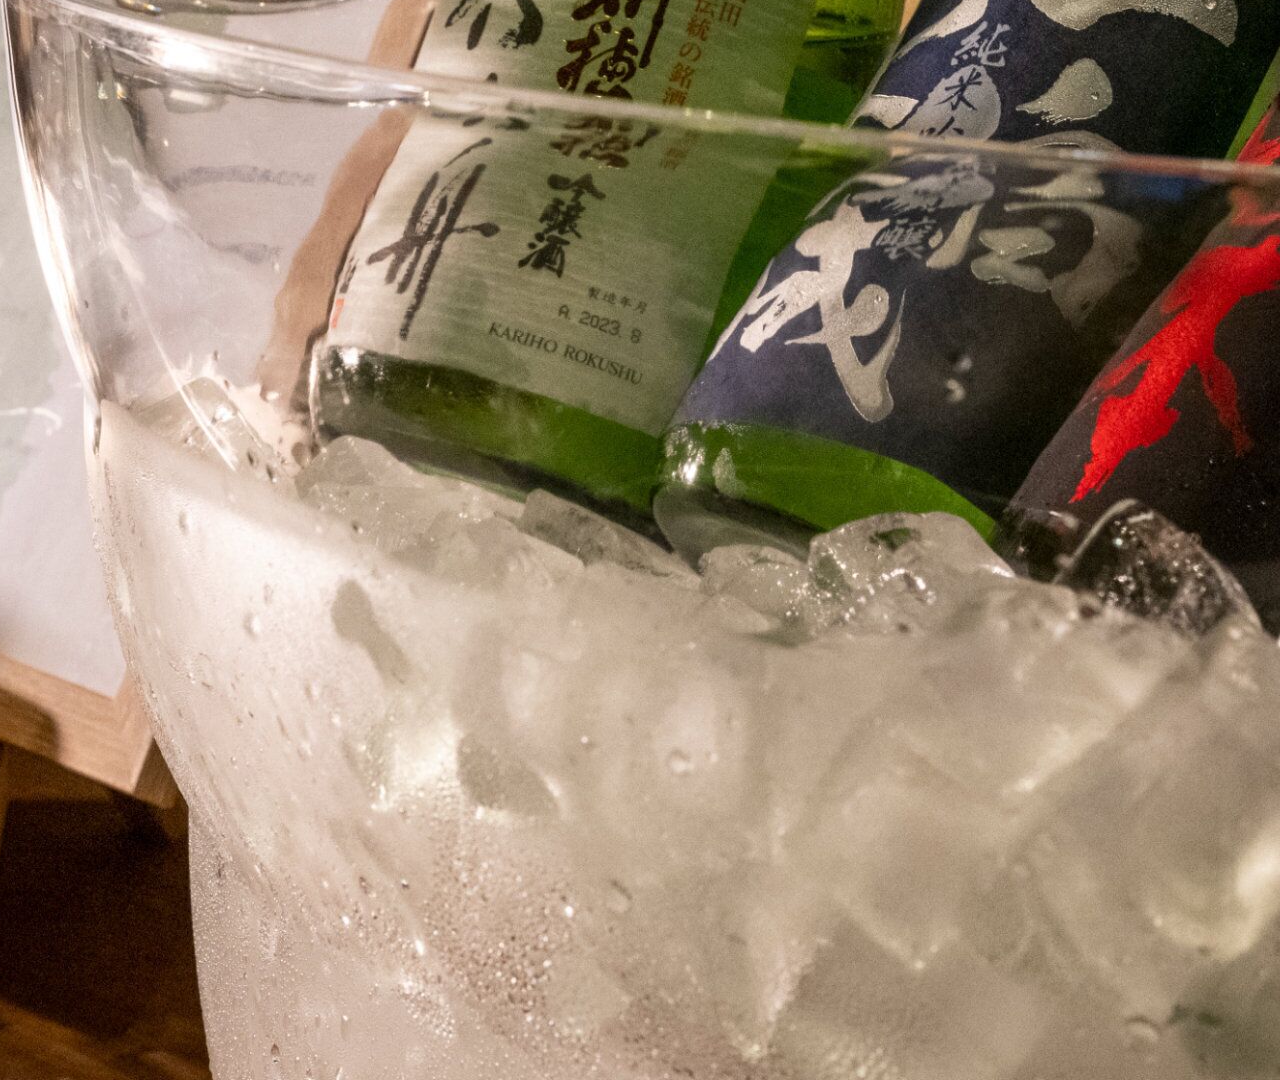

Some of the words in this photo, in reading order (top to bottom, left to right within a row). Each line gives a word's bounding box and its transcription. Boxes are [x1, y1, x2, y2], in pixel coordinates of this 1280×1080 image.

[518, 173, 606, 278] 吟醸酒
[488, 321, 559, 354] KARIHO
[563, 343, 643, 386] ROKUSHU
